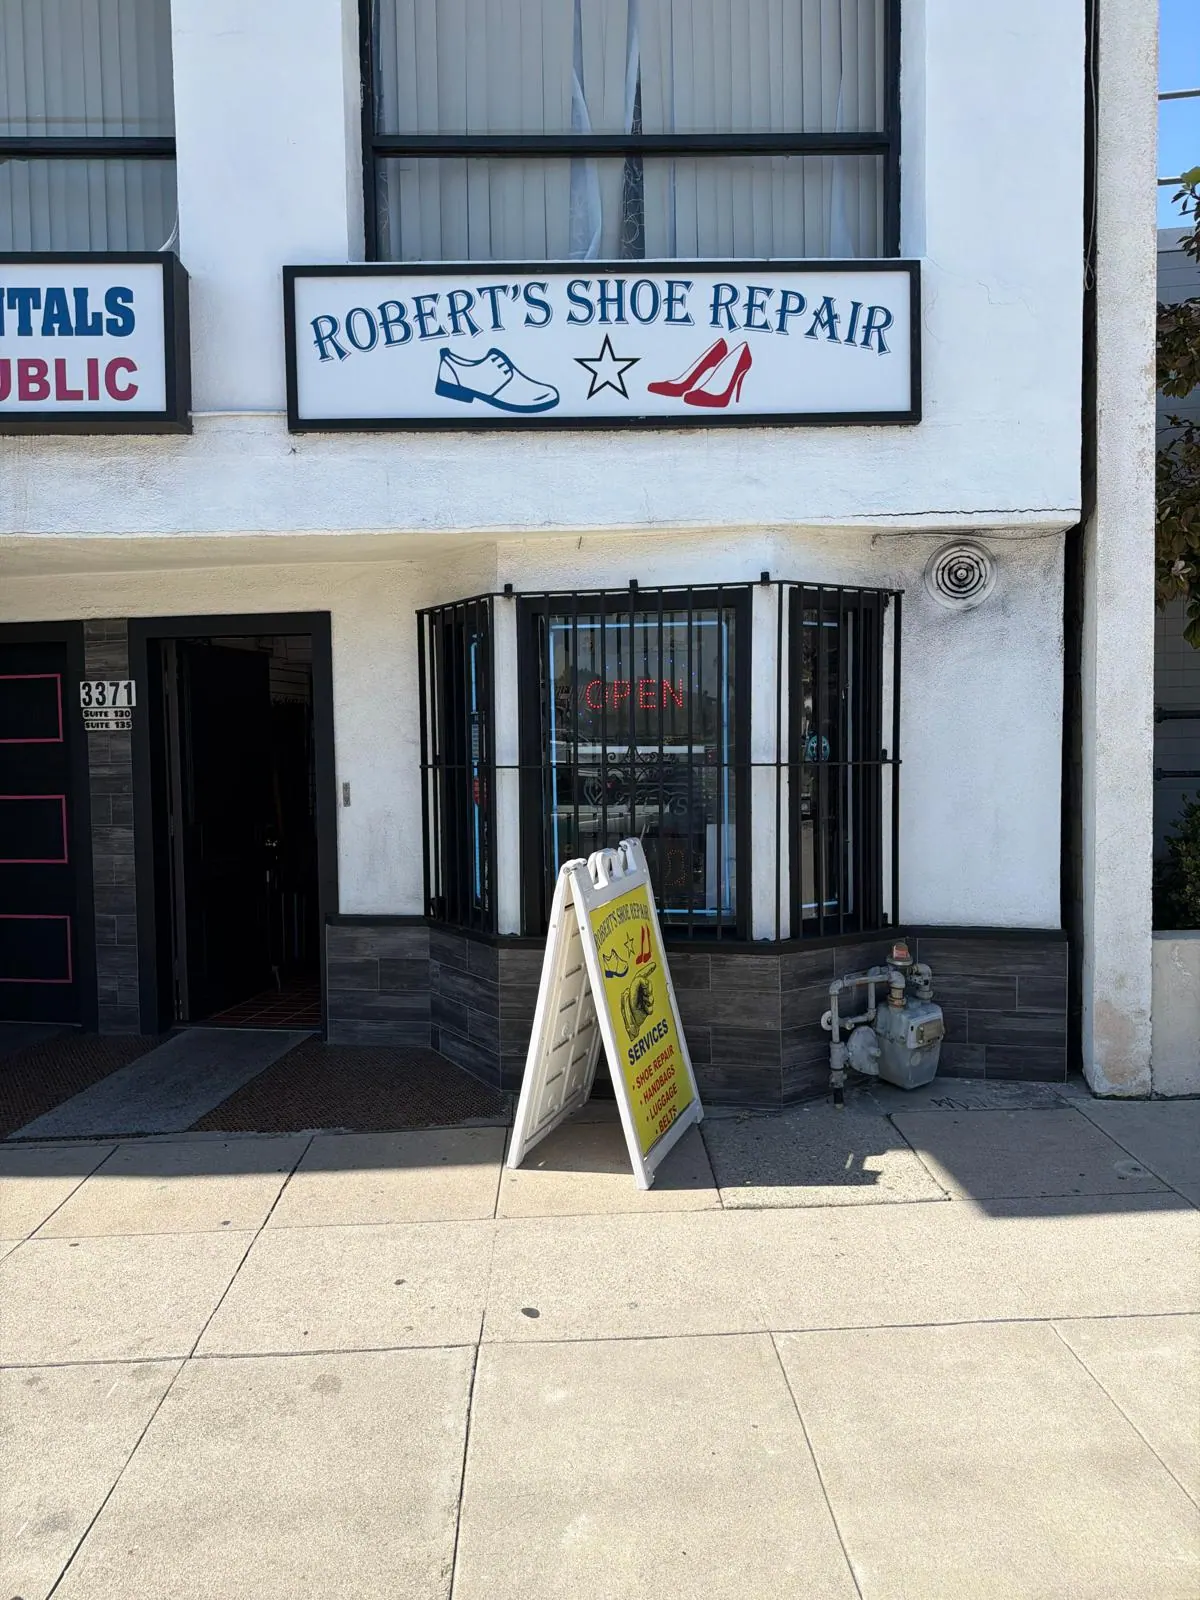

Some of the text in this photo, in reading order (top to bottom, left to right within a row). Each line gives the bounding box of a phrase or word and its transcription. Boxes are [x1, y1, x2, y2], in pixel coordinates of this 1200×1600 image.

[0, 286, 136, 337] TALS
[310, 279, 894, 362] ROBERT'S SHOE REPAIR
[82, 682, 132, 706] 3371
[586, 678, 684, 709] OPEN
[84, 710, 109, 718] SUITE
[115, 721, 131, 729] 135
[628, 1018, 669, 1066] SERVICES
[636, 1044, 675, 1089] SHOE REPAIR
[643, 1064, 676, 1105] HANDBAGS
[649, 1083, 678, 1121] LUGGAGE
[659, 1104, 678, 1134] BELTS
